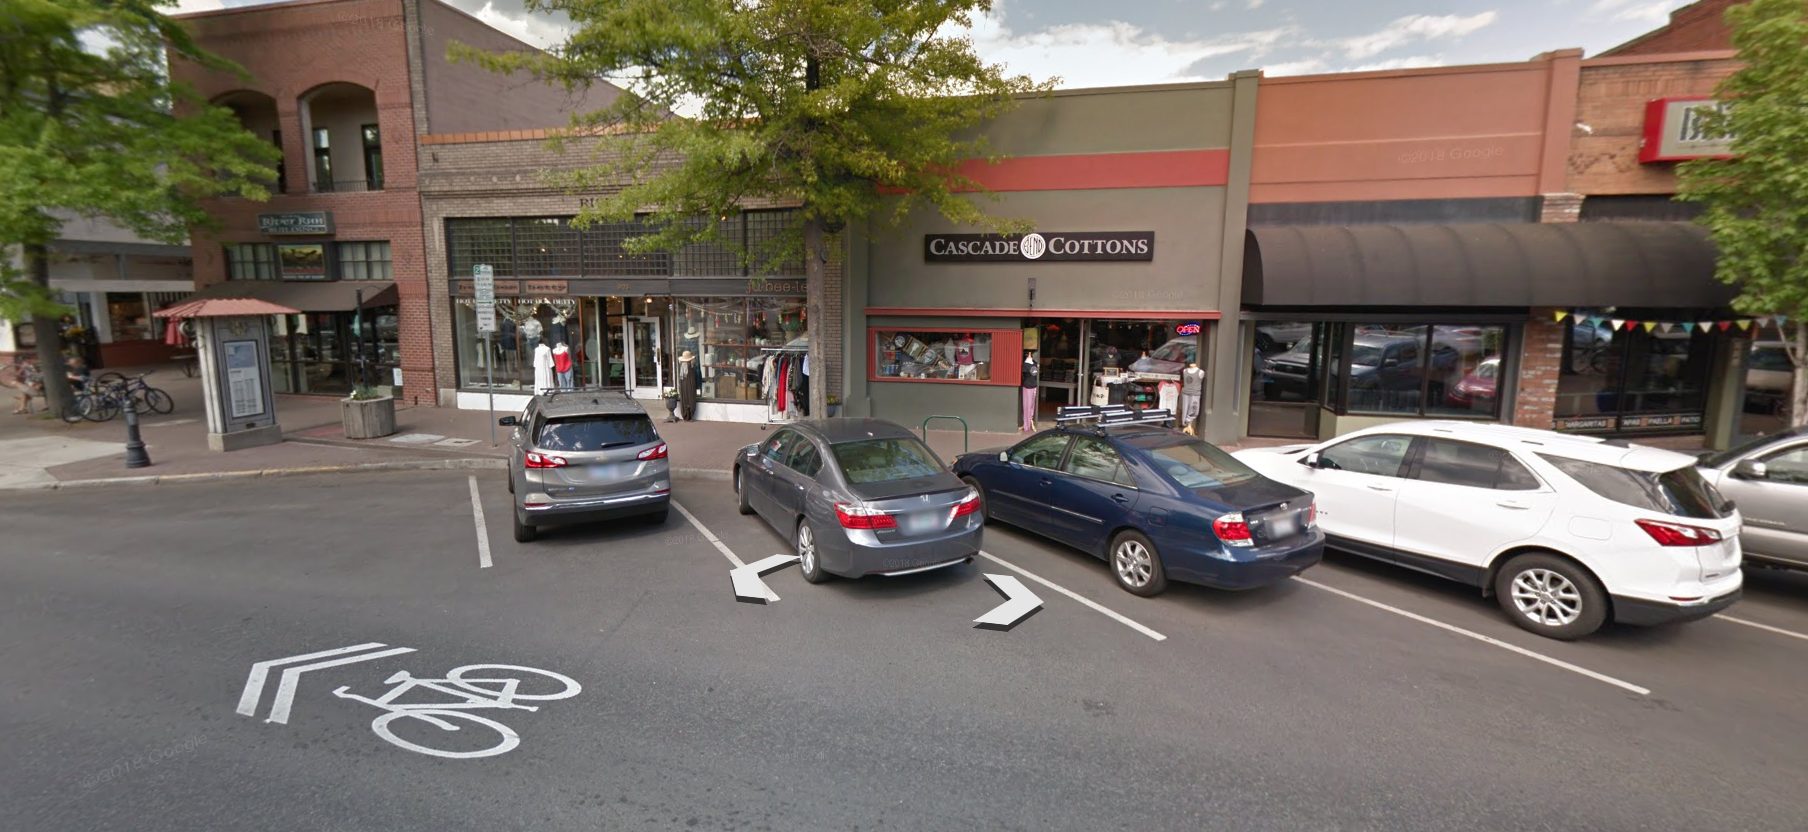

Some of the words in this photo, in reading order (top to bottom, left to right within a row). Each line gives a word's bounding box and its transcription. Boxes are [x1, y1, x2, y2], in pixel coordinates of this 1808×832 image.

[299, 217, 323, 225] Run
[929, 238, 1019, 256] CASCADE
[1048, 237, 1149, 255] COTTONS
[1176, 325, 1200, 334] OPEN
